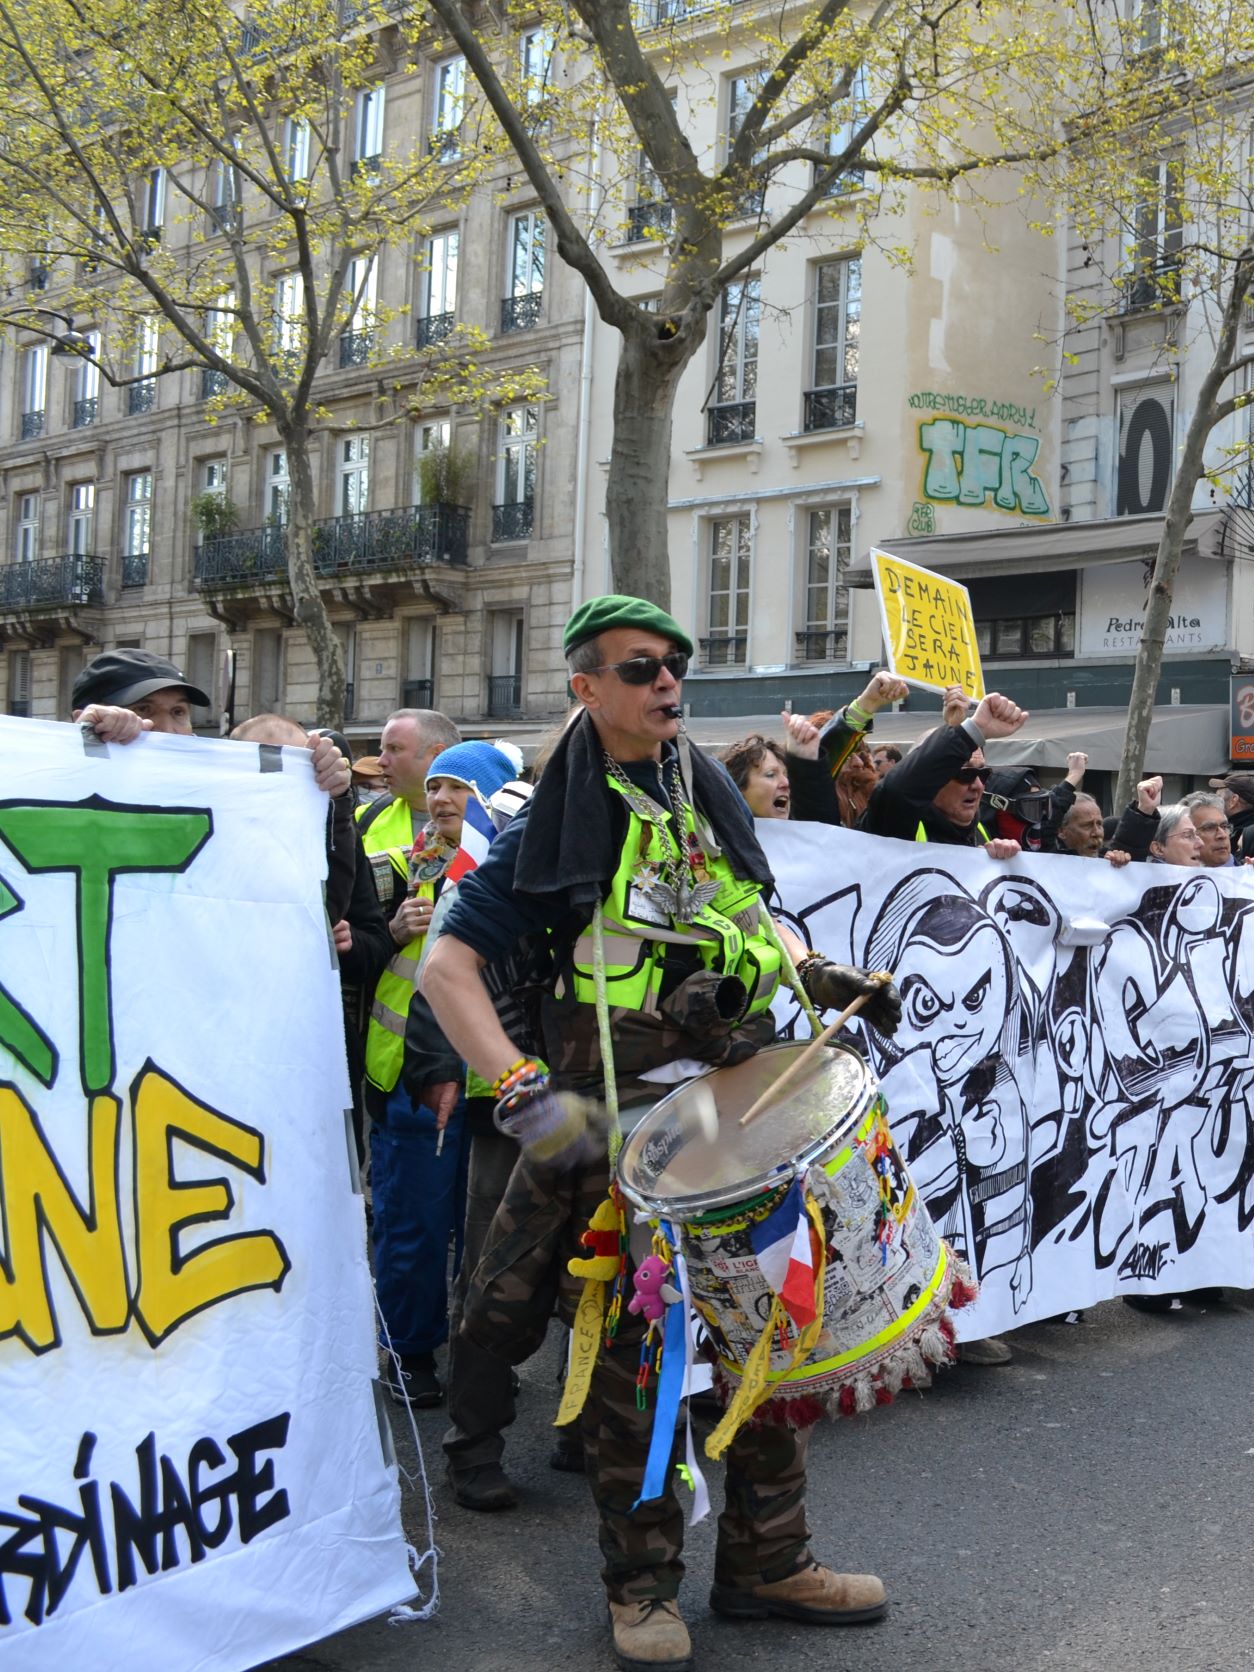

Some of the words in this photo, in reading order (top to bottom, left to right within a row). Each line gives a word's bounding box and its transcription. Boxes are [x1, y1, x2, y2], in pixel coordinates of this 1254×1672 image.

[919, 417, 1050, 515] TFR
[884, 566, 968, 622] DEMAIN
[902, 604, 923, 628] LE
[929, 614, 970, 646] CIEL
[906, 627, 961, 663] SERA
[1106, 617, 1145, 633] Pedr
[904, 653, 976, 689] JAUNE
[565, 1326, 594, 1414] FRANCE
